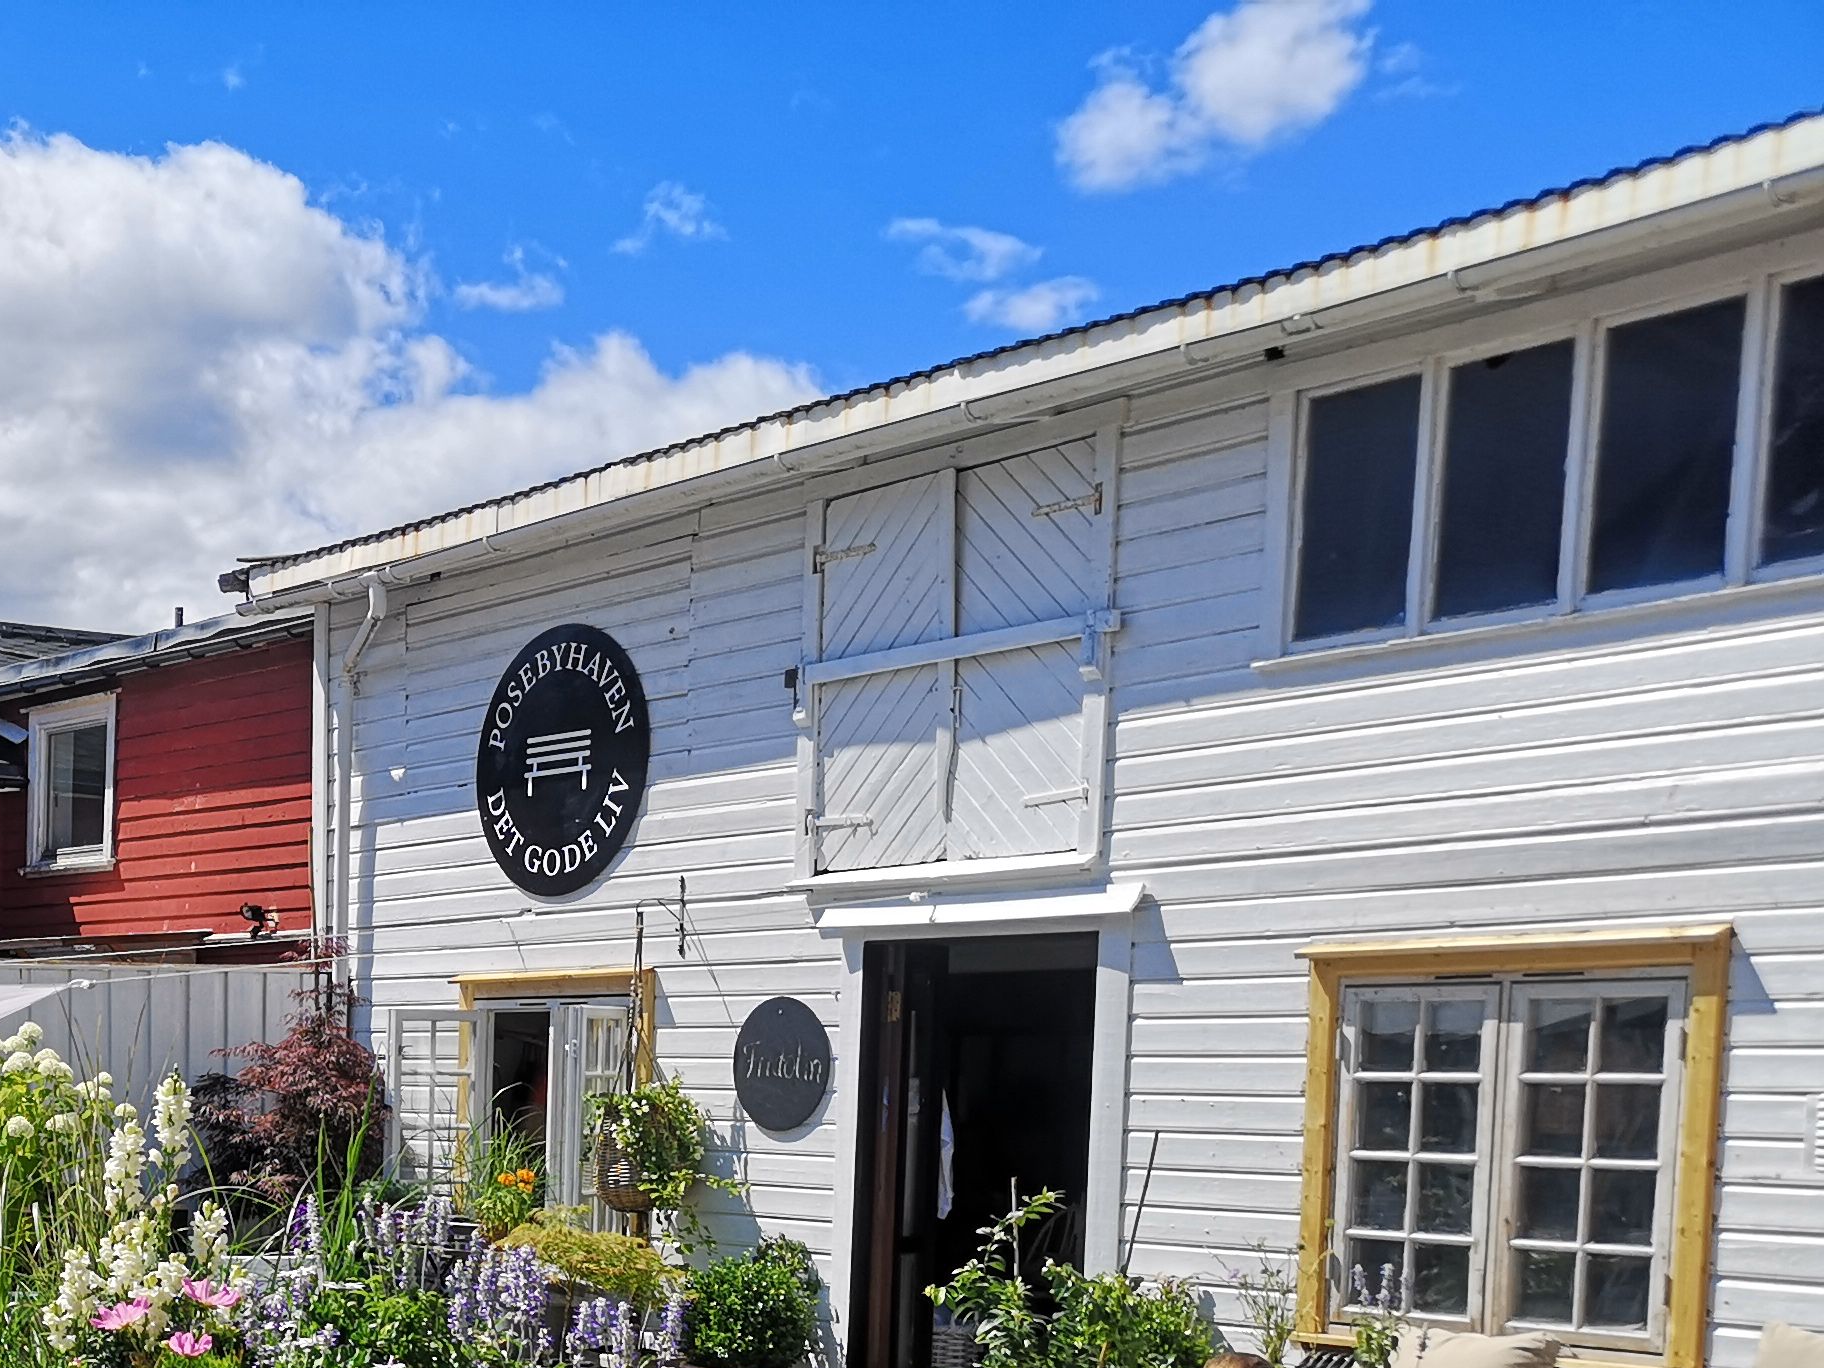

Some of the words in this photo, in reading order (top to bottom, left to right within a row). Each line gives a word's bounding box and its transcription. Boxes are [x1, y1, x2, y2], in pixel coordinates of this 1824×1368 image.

[488, 642, 635, 752] POSEBYHAVEN
[486, 786, 525, 856] DET
[524, 829, 598, 876] GODE
[593, 768, 630, 838] LIV
